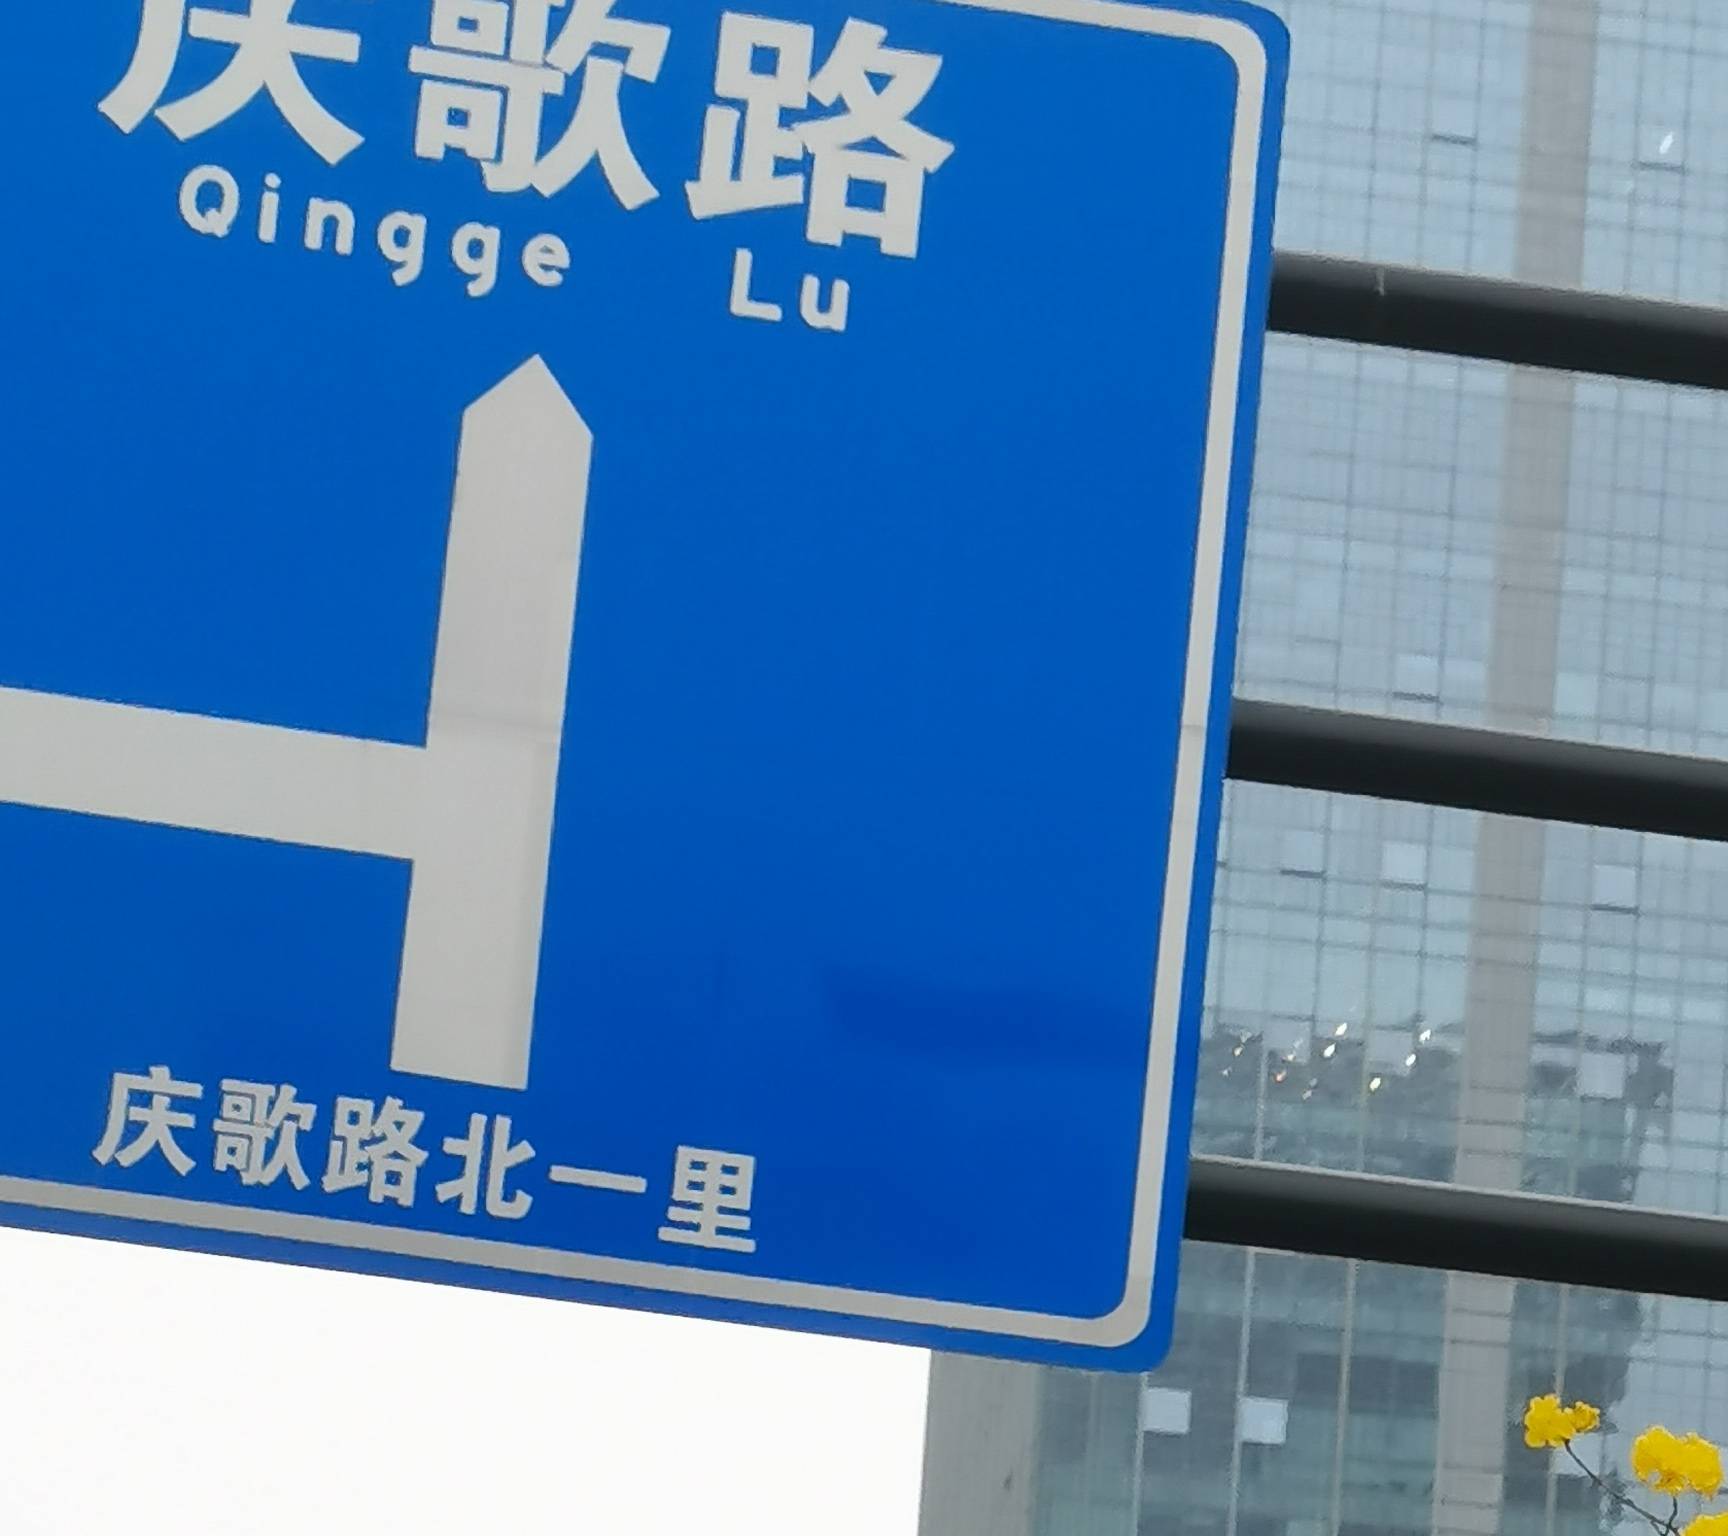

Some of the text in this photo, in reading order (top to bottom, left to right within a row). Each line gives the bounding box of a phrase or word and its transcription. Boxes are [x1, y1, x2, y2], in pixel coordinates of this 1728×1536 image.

[177, 163, 851, 333] Qingge Lu
[91, 1064, 759, 1254] 庆歌路北一里
